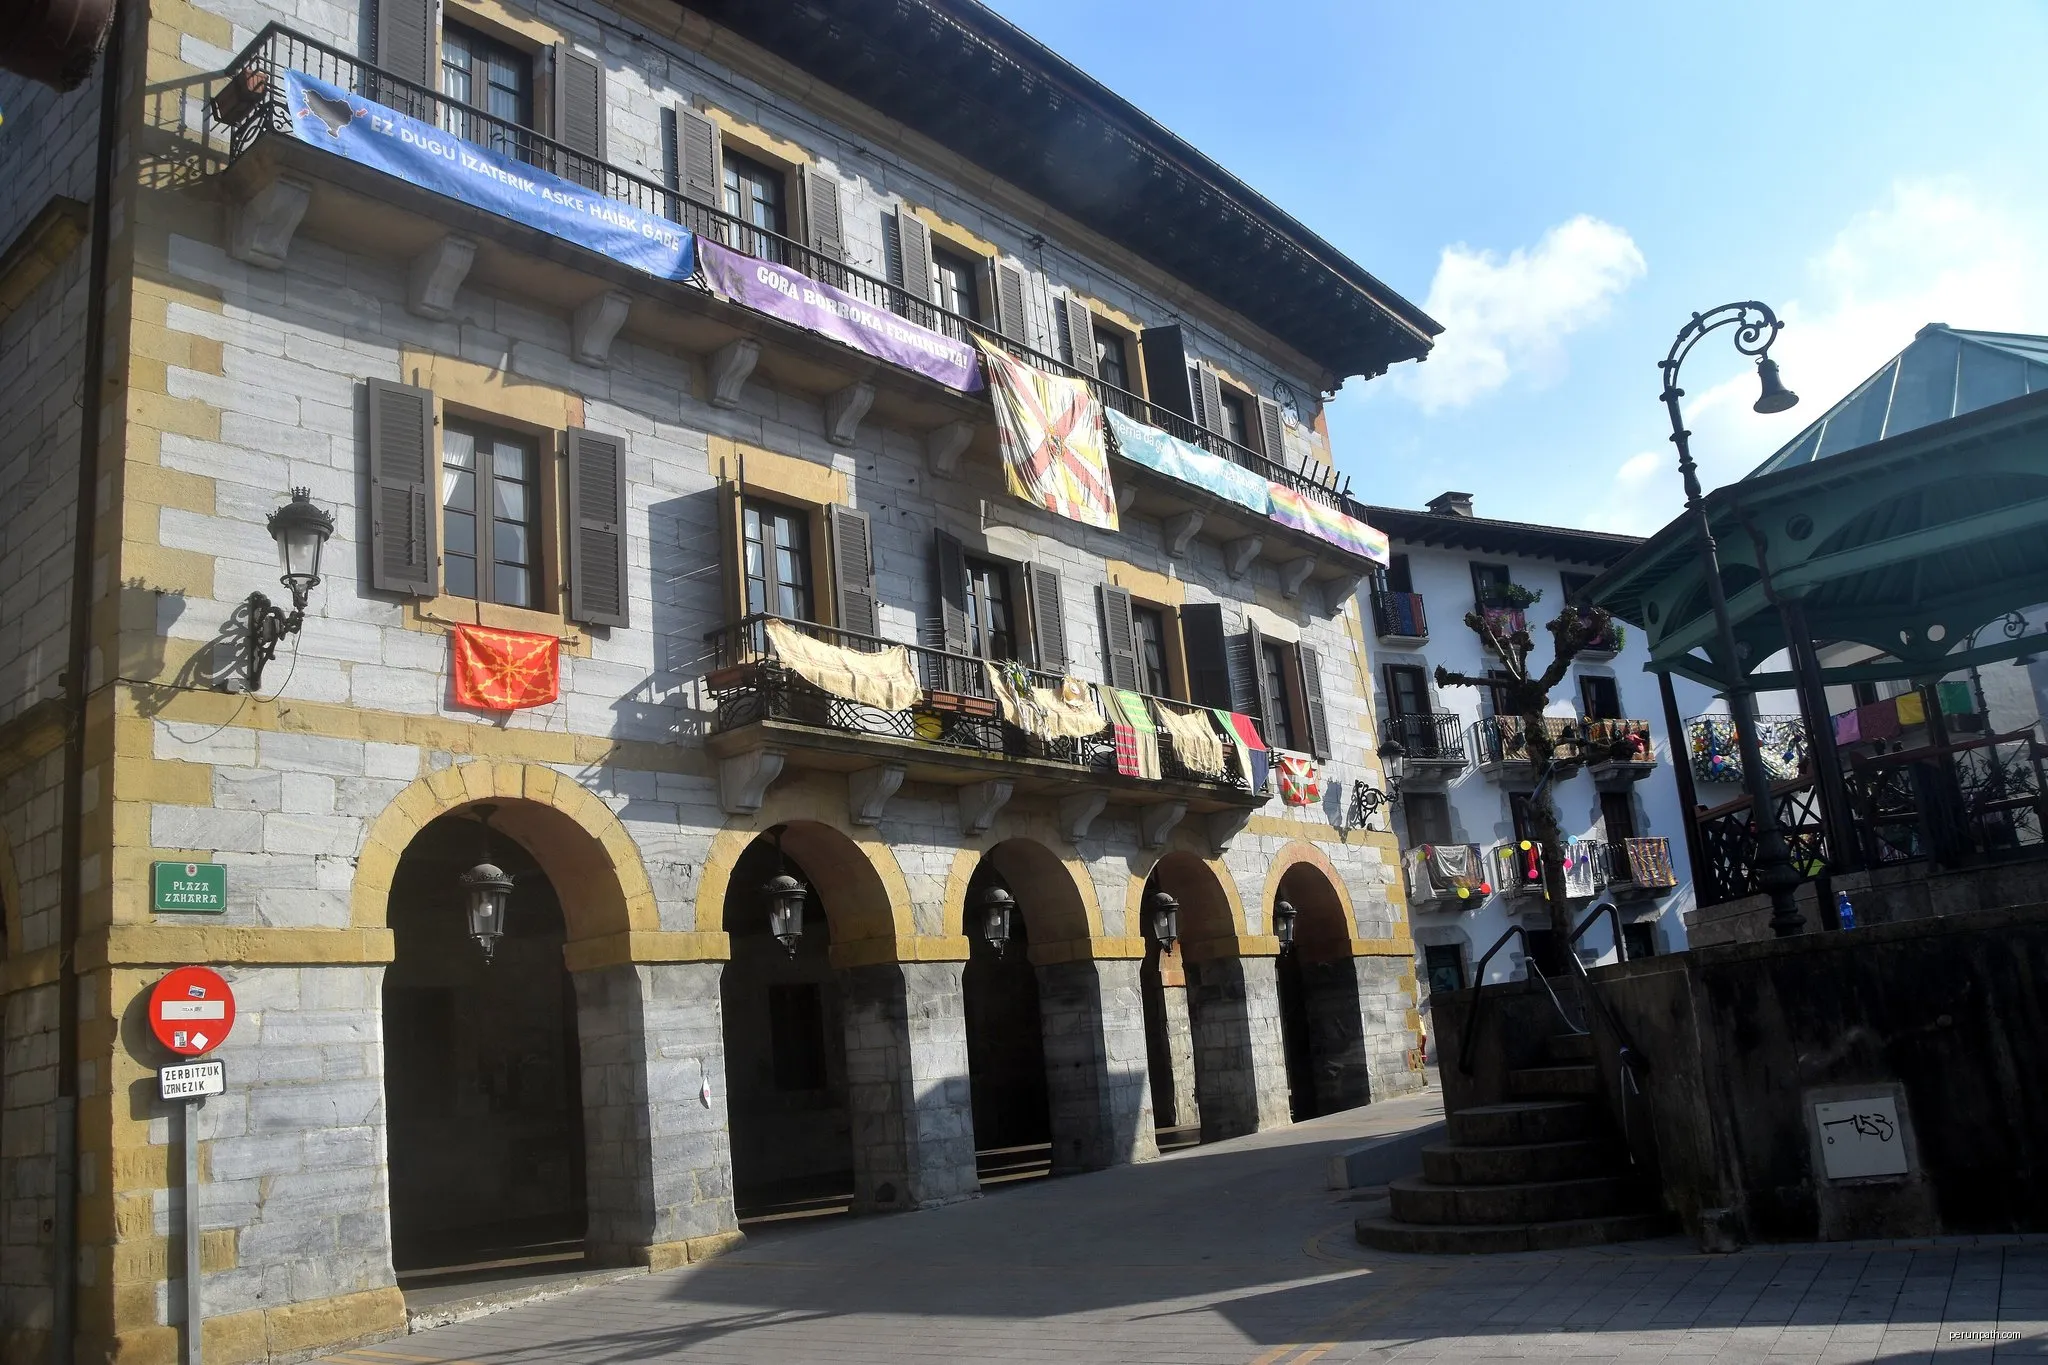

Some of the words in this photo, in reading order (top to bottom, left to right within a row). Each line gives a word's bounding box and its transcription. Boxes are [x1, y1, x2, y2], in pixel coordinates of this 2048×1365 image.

[371, 115, 394, 137] EZ
[401, 128, 456, 160] DUGU
[460, 151, 537, 196] IZATERIK
[541, 188, 585, 213] ASKE
[589, 203, 638, 233] HAIEK
[642, 223, 680, 251] GABE
[757, 266, 799, 300] GORA
[803, 288, 884, 333] BORROKA
[886, 324, 968, 370] FEMINISTA!
[173, 881, 209, 892] PLAZA
[164, 893, 218, 904] ZAHARRA
[165, 1066, 219, 1081] ZERBITZUK
